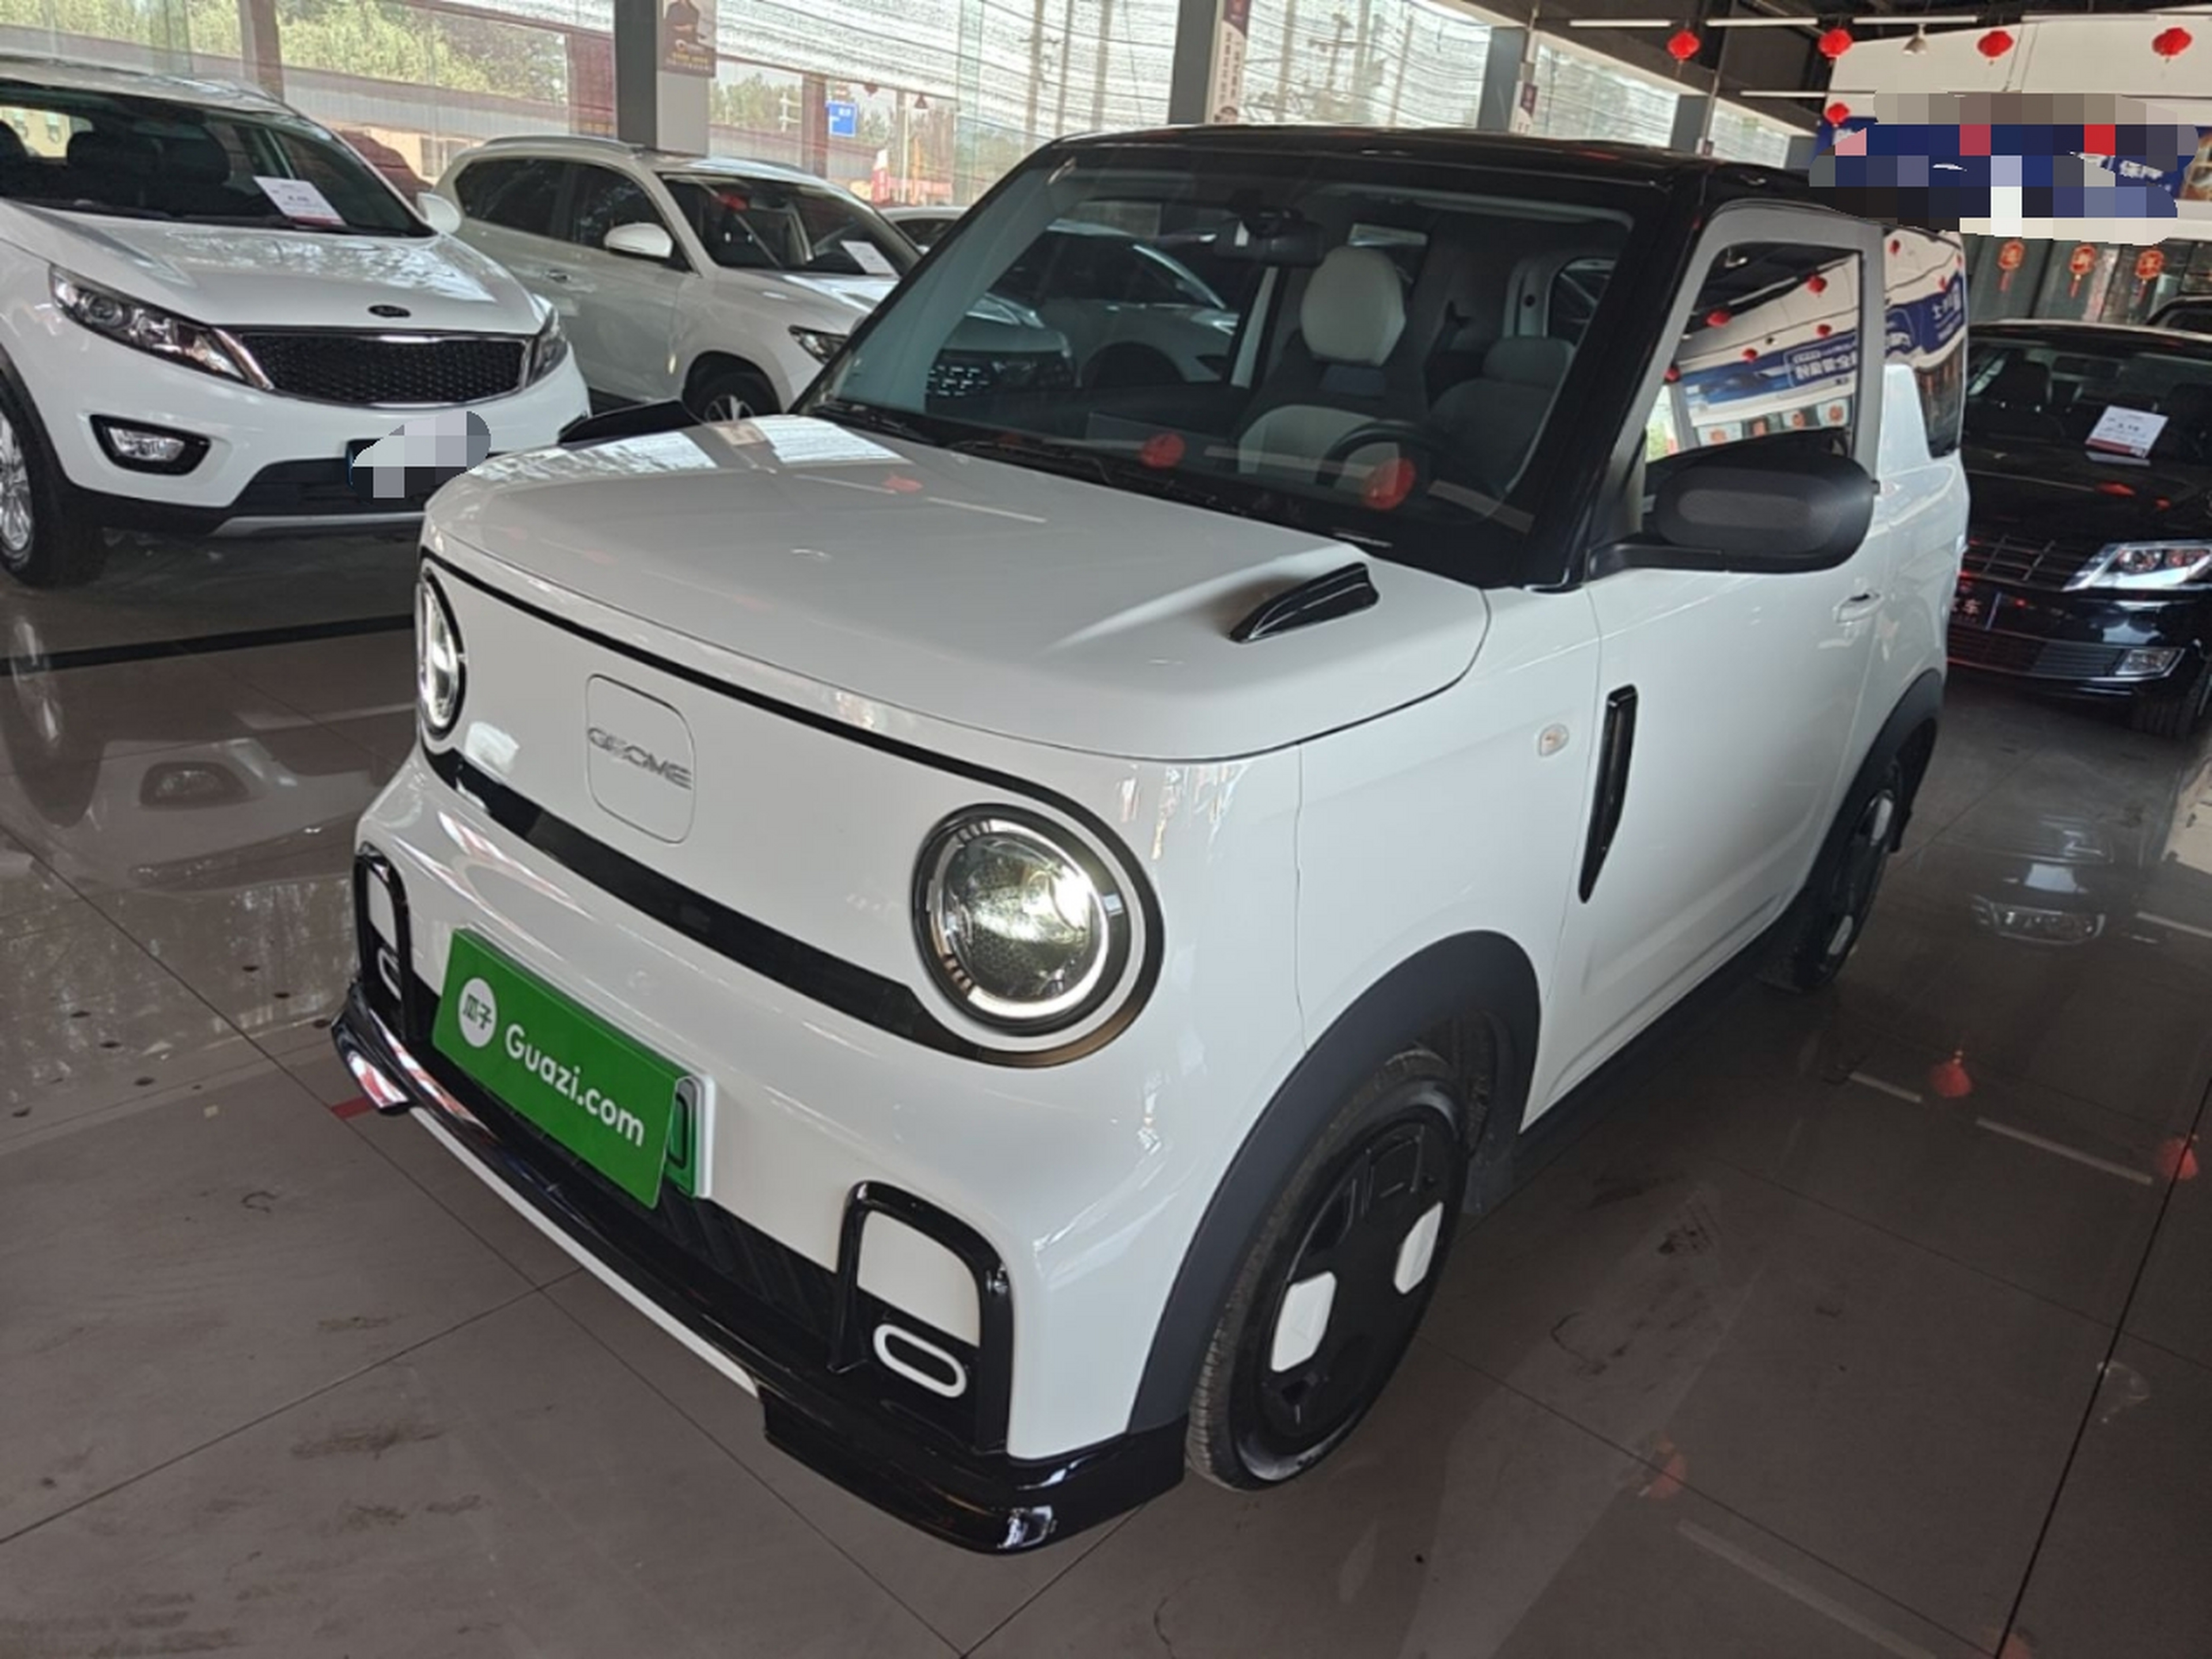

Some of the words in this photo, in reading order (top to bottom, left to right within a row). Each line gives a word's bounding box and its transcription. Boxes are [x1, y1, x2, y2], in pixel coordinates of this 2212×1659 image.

[587, 727, 692, 790] GEOME
[463, 993, 493, 1030] 瓜子
[505, 1023, 645, 1147] Guazi.com
